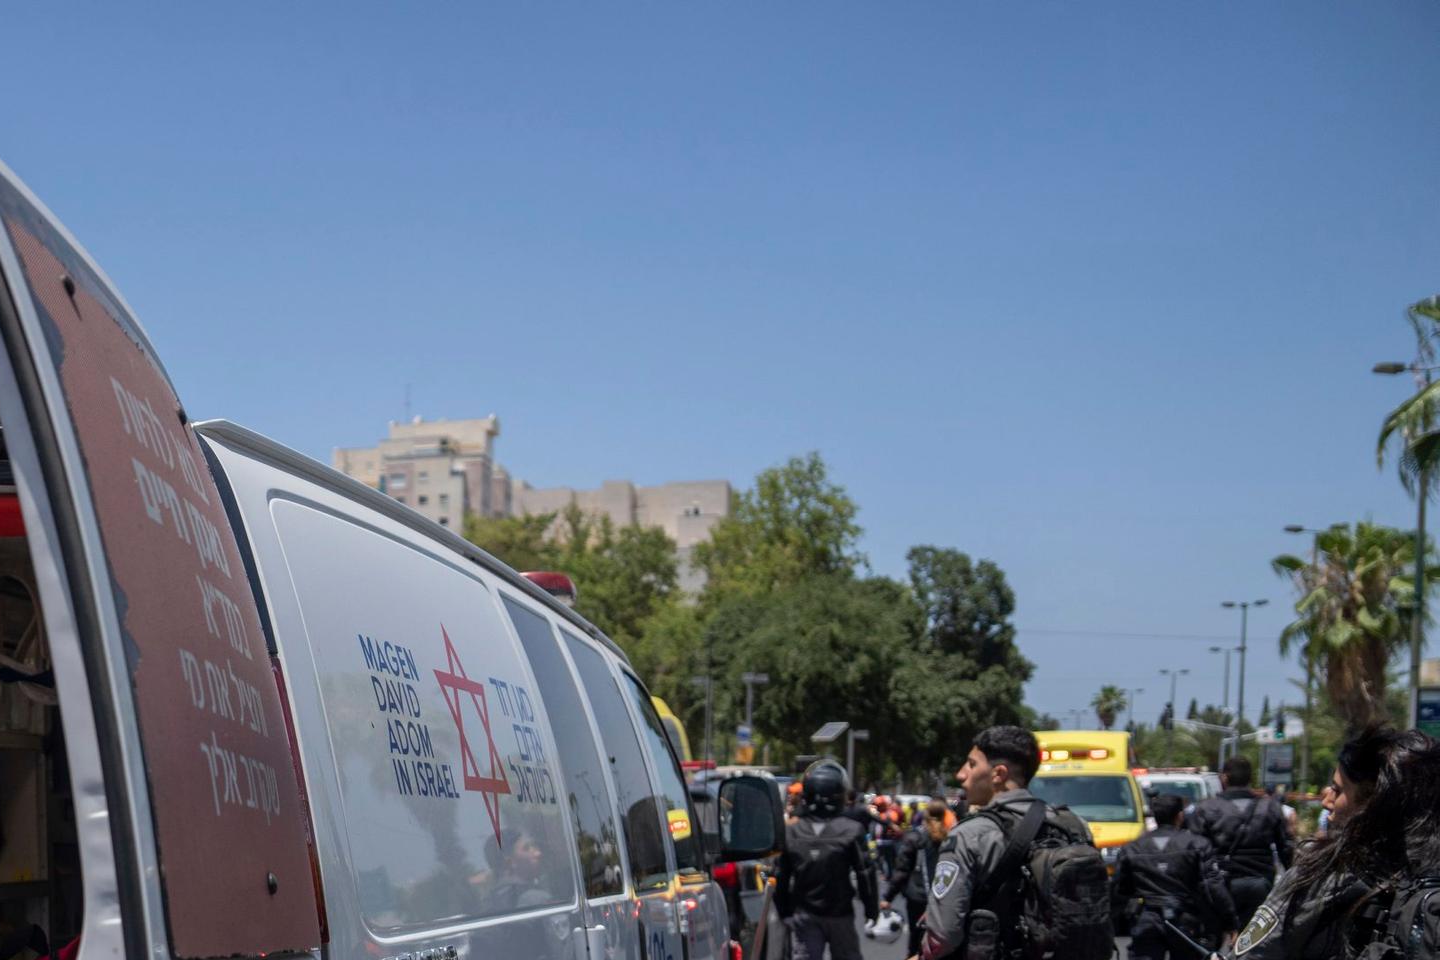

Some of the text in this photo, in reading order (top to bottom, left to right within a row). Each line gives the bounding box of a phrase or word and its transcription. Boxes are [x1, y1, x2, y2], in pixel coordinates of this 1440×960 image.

[131, 457, 192, 545] חיים
[178, 647, 205, 710] מי
[357, 633, 420, 682] MAGEN
[204, 659, 236, 721] את
[371, 675, 421, 718] DAVID
[386, 719, 435, 759] ADOM
[200, 730, 242, 817] אליך
[392, 758, 460, 799] IN ISRAEL
